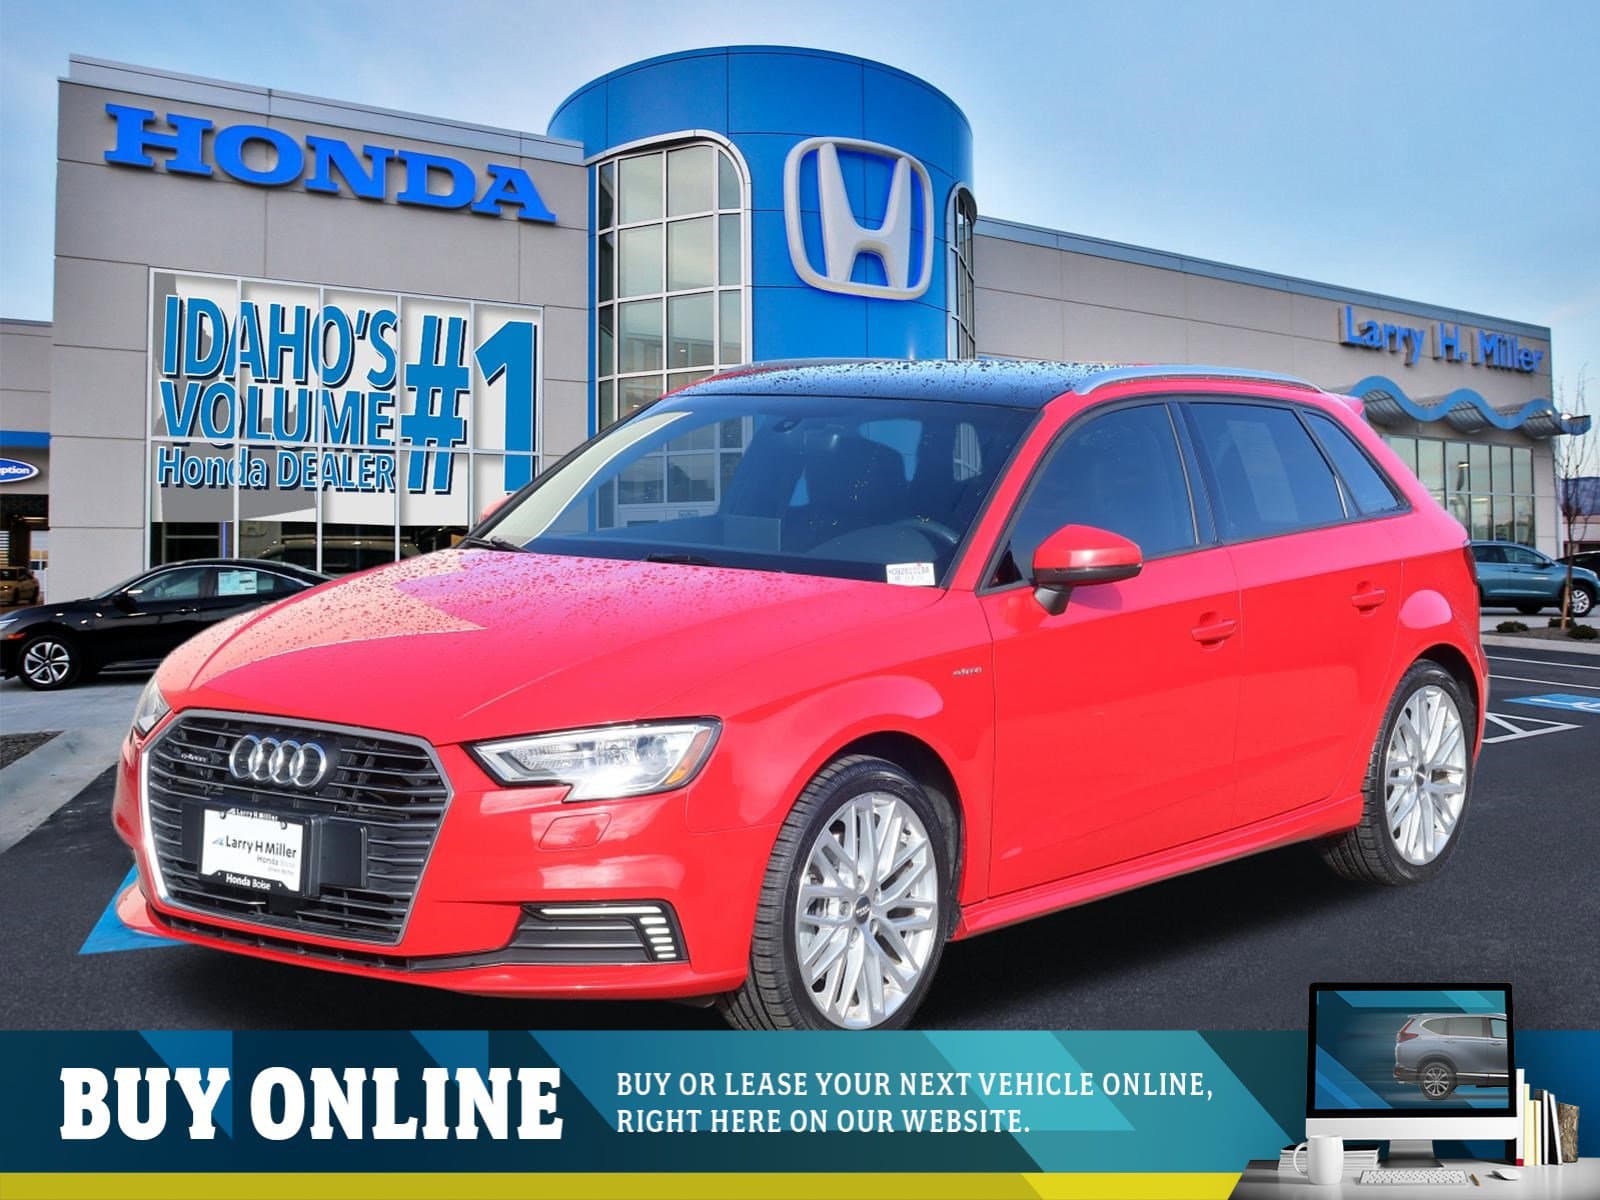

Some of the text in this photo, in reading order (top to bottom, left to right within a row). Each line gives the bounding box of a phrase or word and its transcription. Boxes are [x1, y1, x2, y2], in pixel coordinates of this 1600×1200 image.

[104, 103, 557, 225] HONDA
[163, 295, 399, 389] IDAHO'S
[1340, 304, 1544, 371] Larry H. Miller
[159, 380, 396, 450] VOLUME
[400, 315, 538, 496] #1
[157, 446, 397, 492] Honda DEALER
[225, 873, 251, 887] Honda
[226, 835, 296, 858] Larry H Miller
